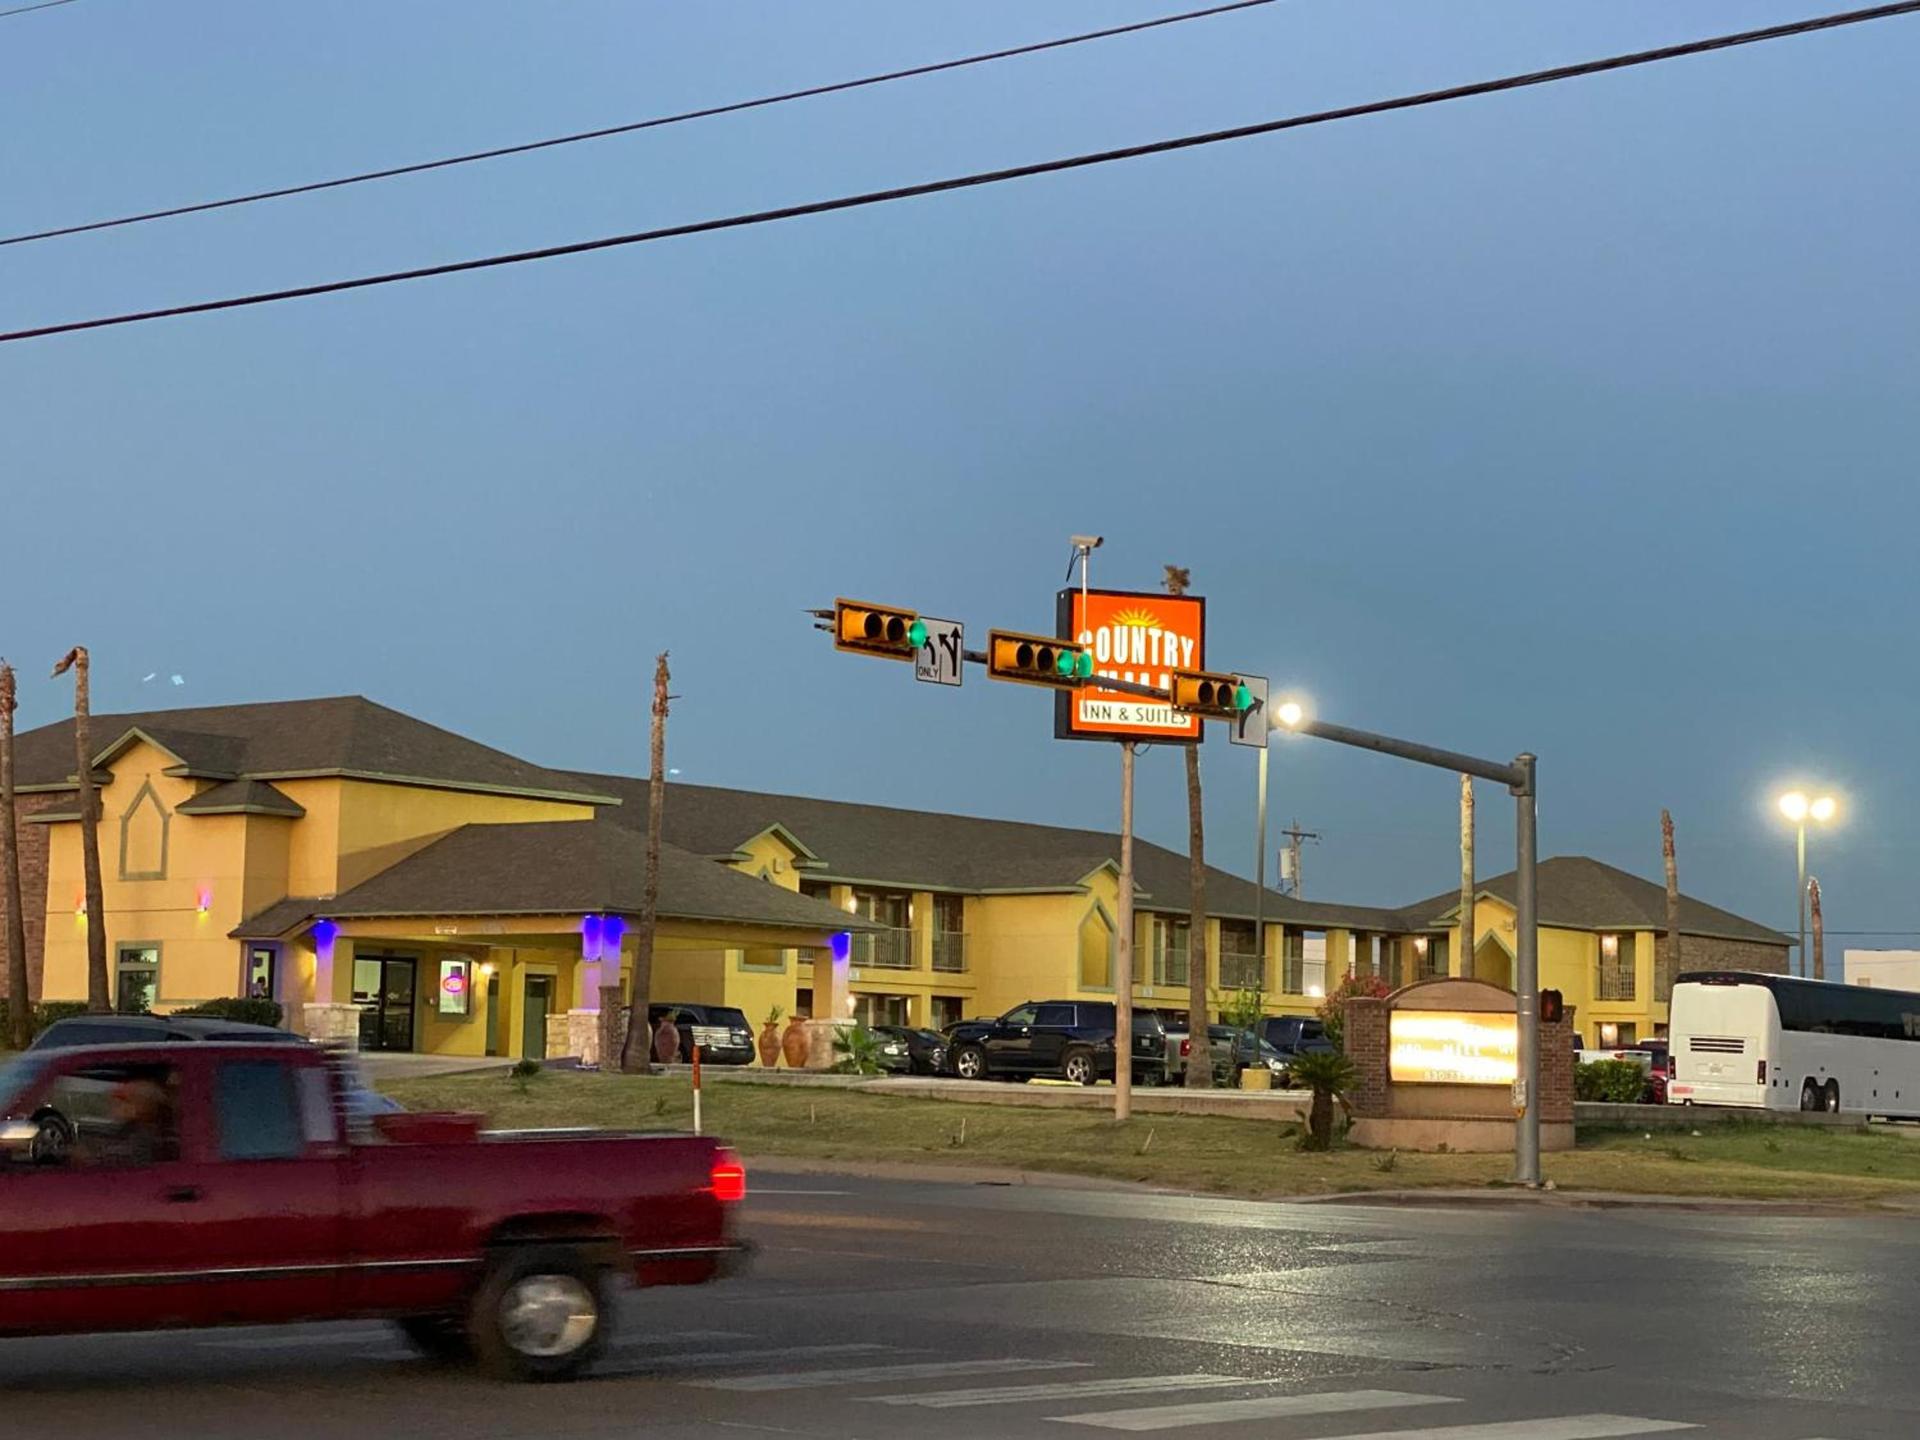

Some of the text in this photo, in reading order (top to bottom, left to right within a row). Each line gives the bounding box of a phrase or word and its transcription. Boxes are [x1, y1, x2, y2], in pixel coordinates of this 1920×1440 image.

[1078, 625, 1194, 668] COUNTRY
[918, 666, 939, 678] ONLY
[1083, 705, 1187, 725] INN & SUITES
